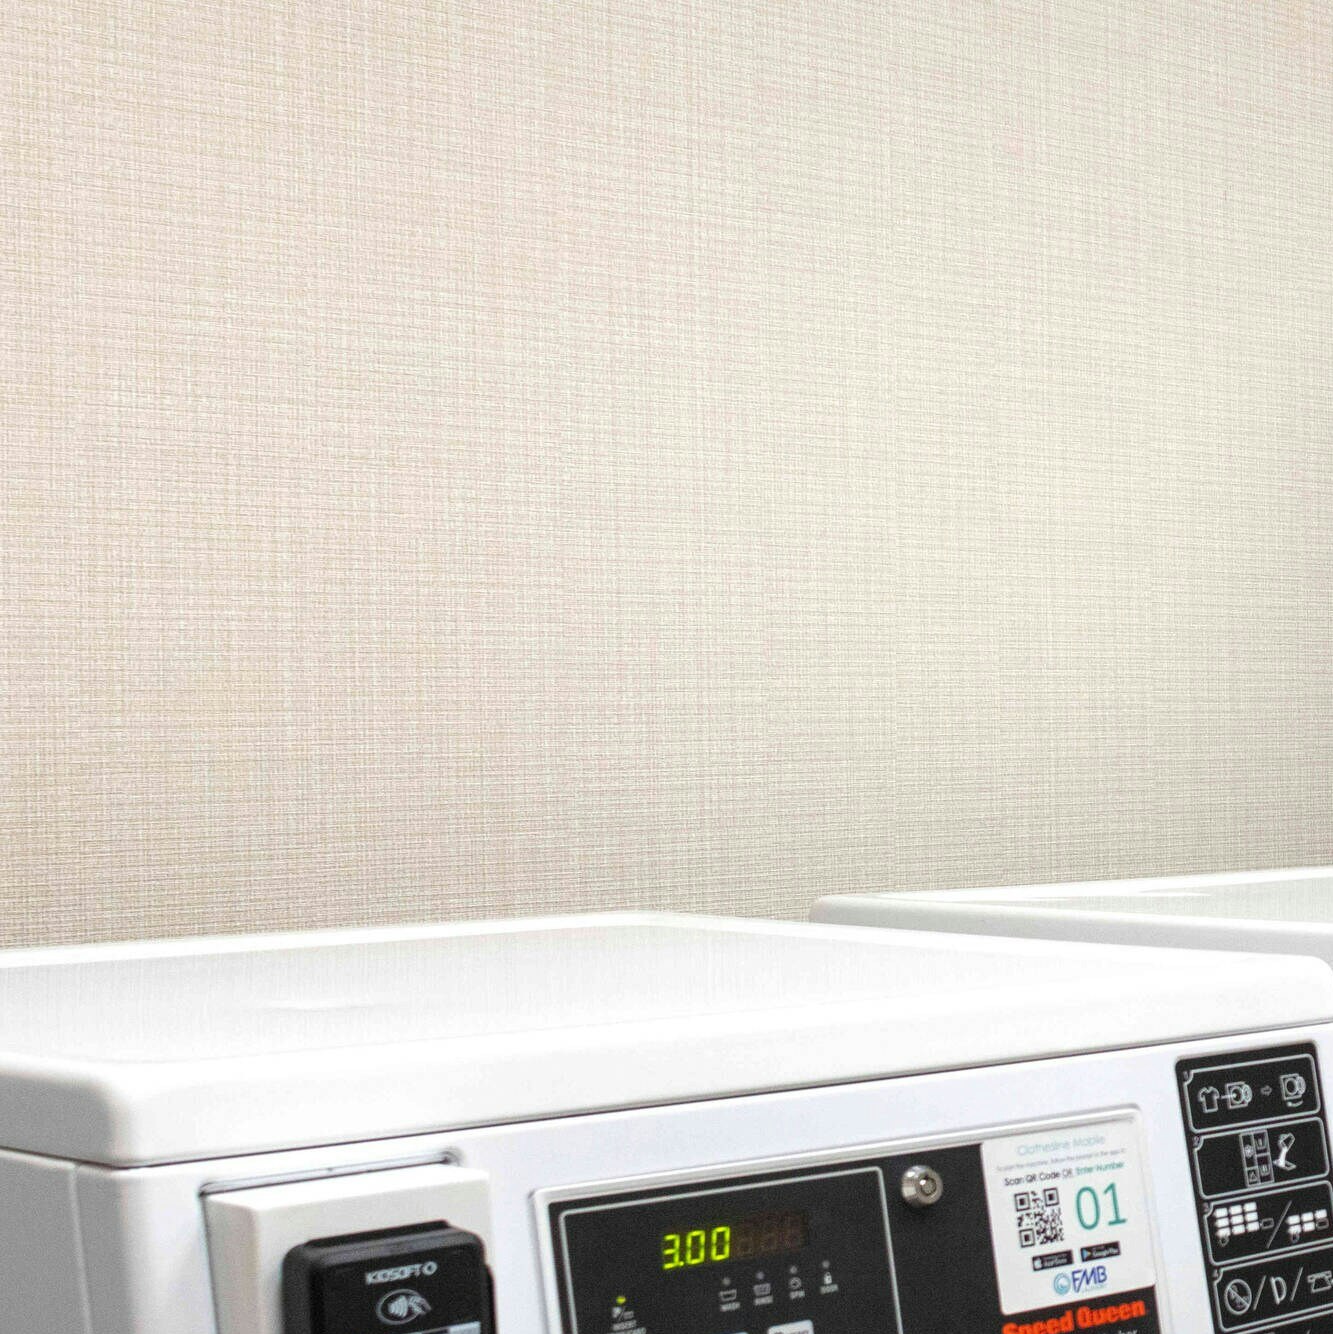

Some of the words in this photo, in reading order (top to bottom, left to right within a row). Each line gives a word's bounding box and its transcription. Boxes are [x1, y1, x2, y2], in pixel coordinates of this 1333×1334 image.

[1004, 1176, 1024, 1186] Scan
[1025, 1174, 1037, 1183] QR
[1040, 1170, 1060, 1182] Code
[1076, 1182, 1127, 1230] 01
[662, 1226, 730, 1270] 3.00
[1071, 1266, 1108, 1293] FMB
[1076, 1300, 1146, 1330] Queen
